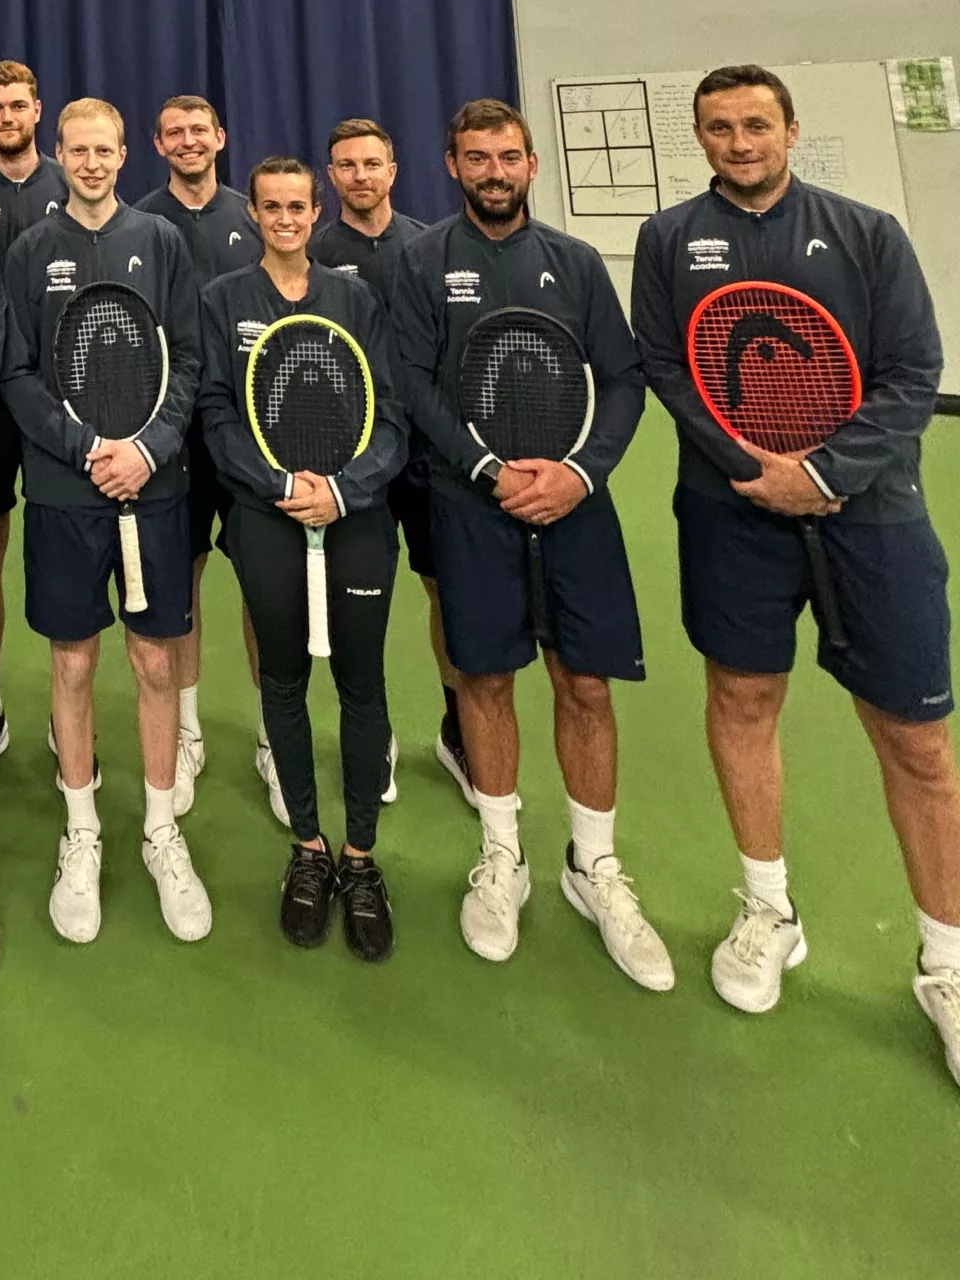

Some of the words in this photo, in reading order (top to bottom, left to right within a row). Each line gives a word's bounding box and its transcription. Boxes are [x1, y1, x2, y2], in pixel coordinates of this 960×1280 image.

[694, 255, 723, 263] Tennis
[689, 263, 730, 271] Academy
[450, 287, 475, 295] Tennis
[446, 295, 481, 303] Academy
[347, 587, 381, 596] HEAD
